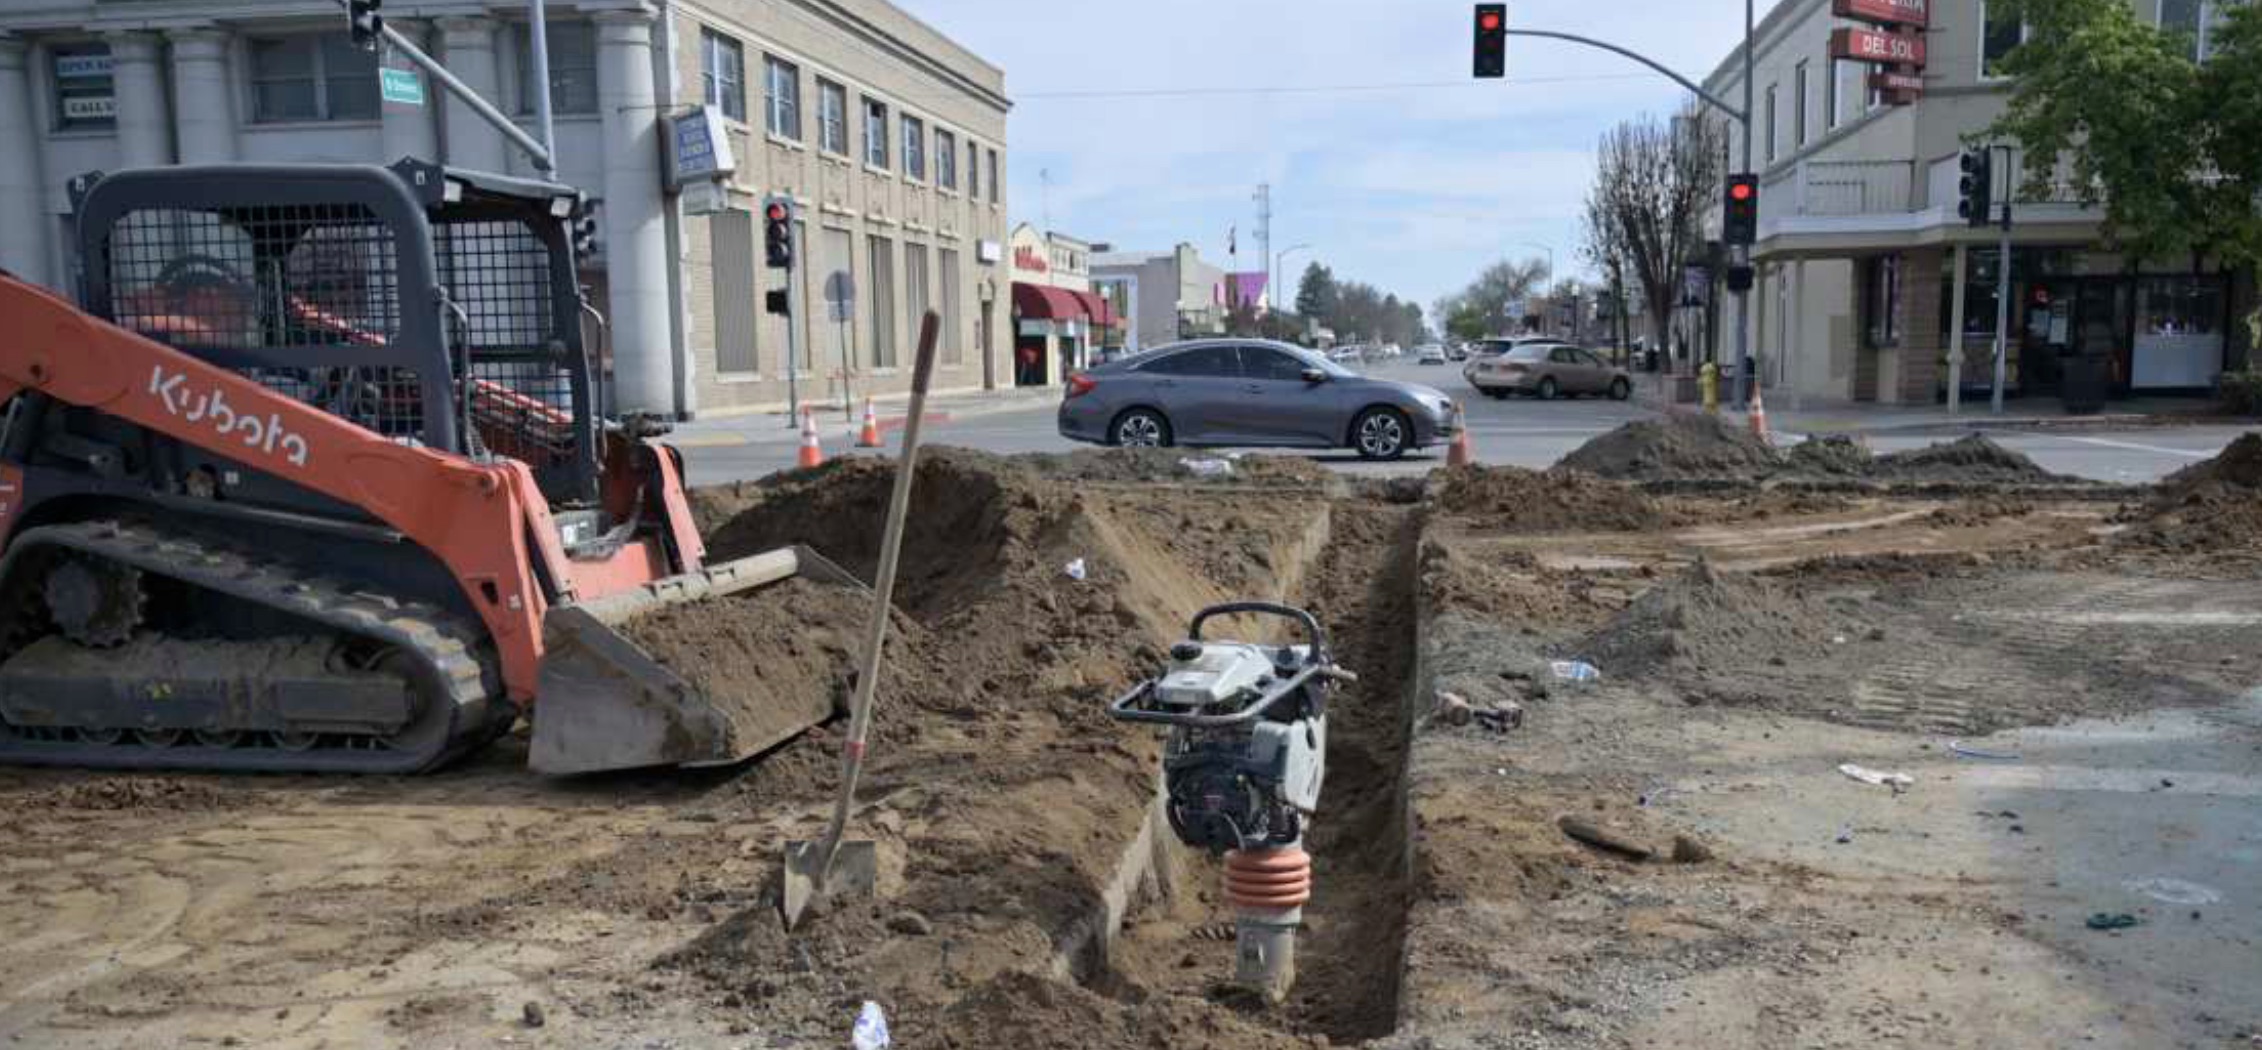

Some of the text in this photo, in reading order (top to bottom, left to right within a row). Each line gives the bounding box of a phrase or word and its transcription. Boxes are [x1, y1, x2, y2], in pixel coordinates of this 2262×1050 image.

[1862, 34, 1915, 60] DEL SOL
[148, 364, 309, 467] Kubota
